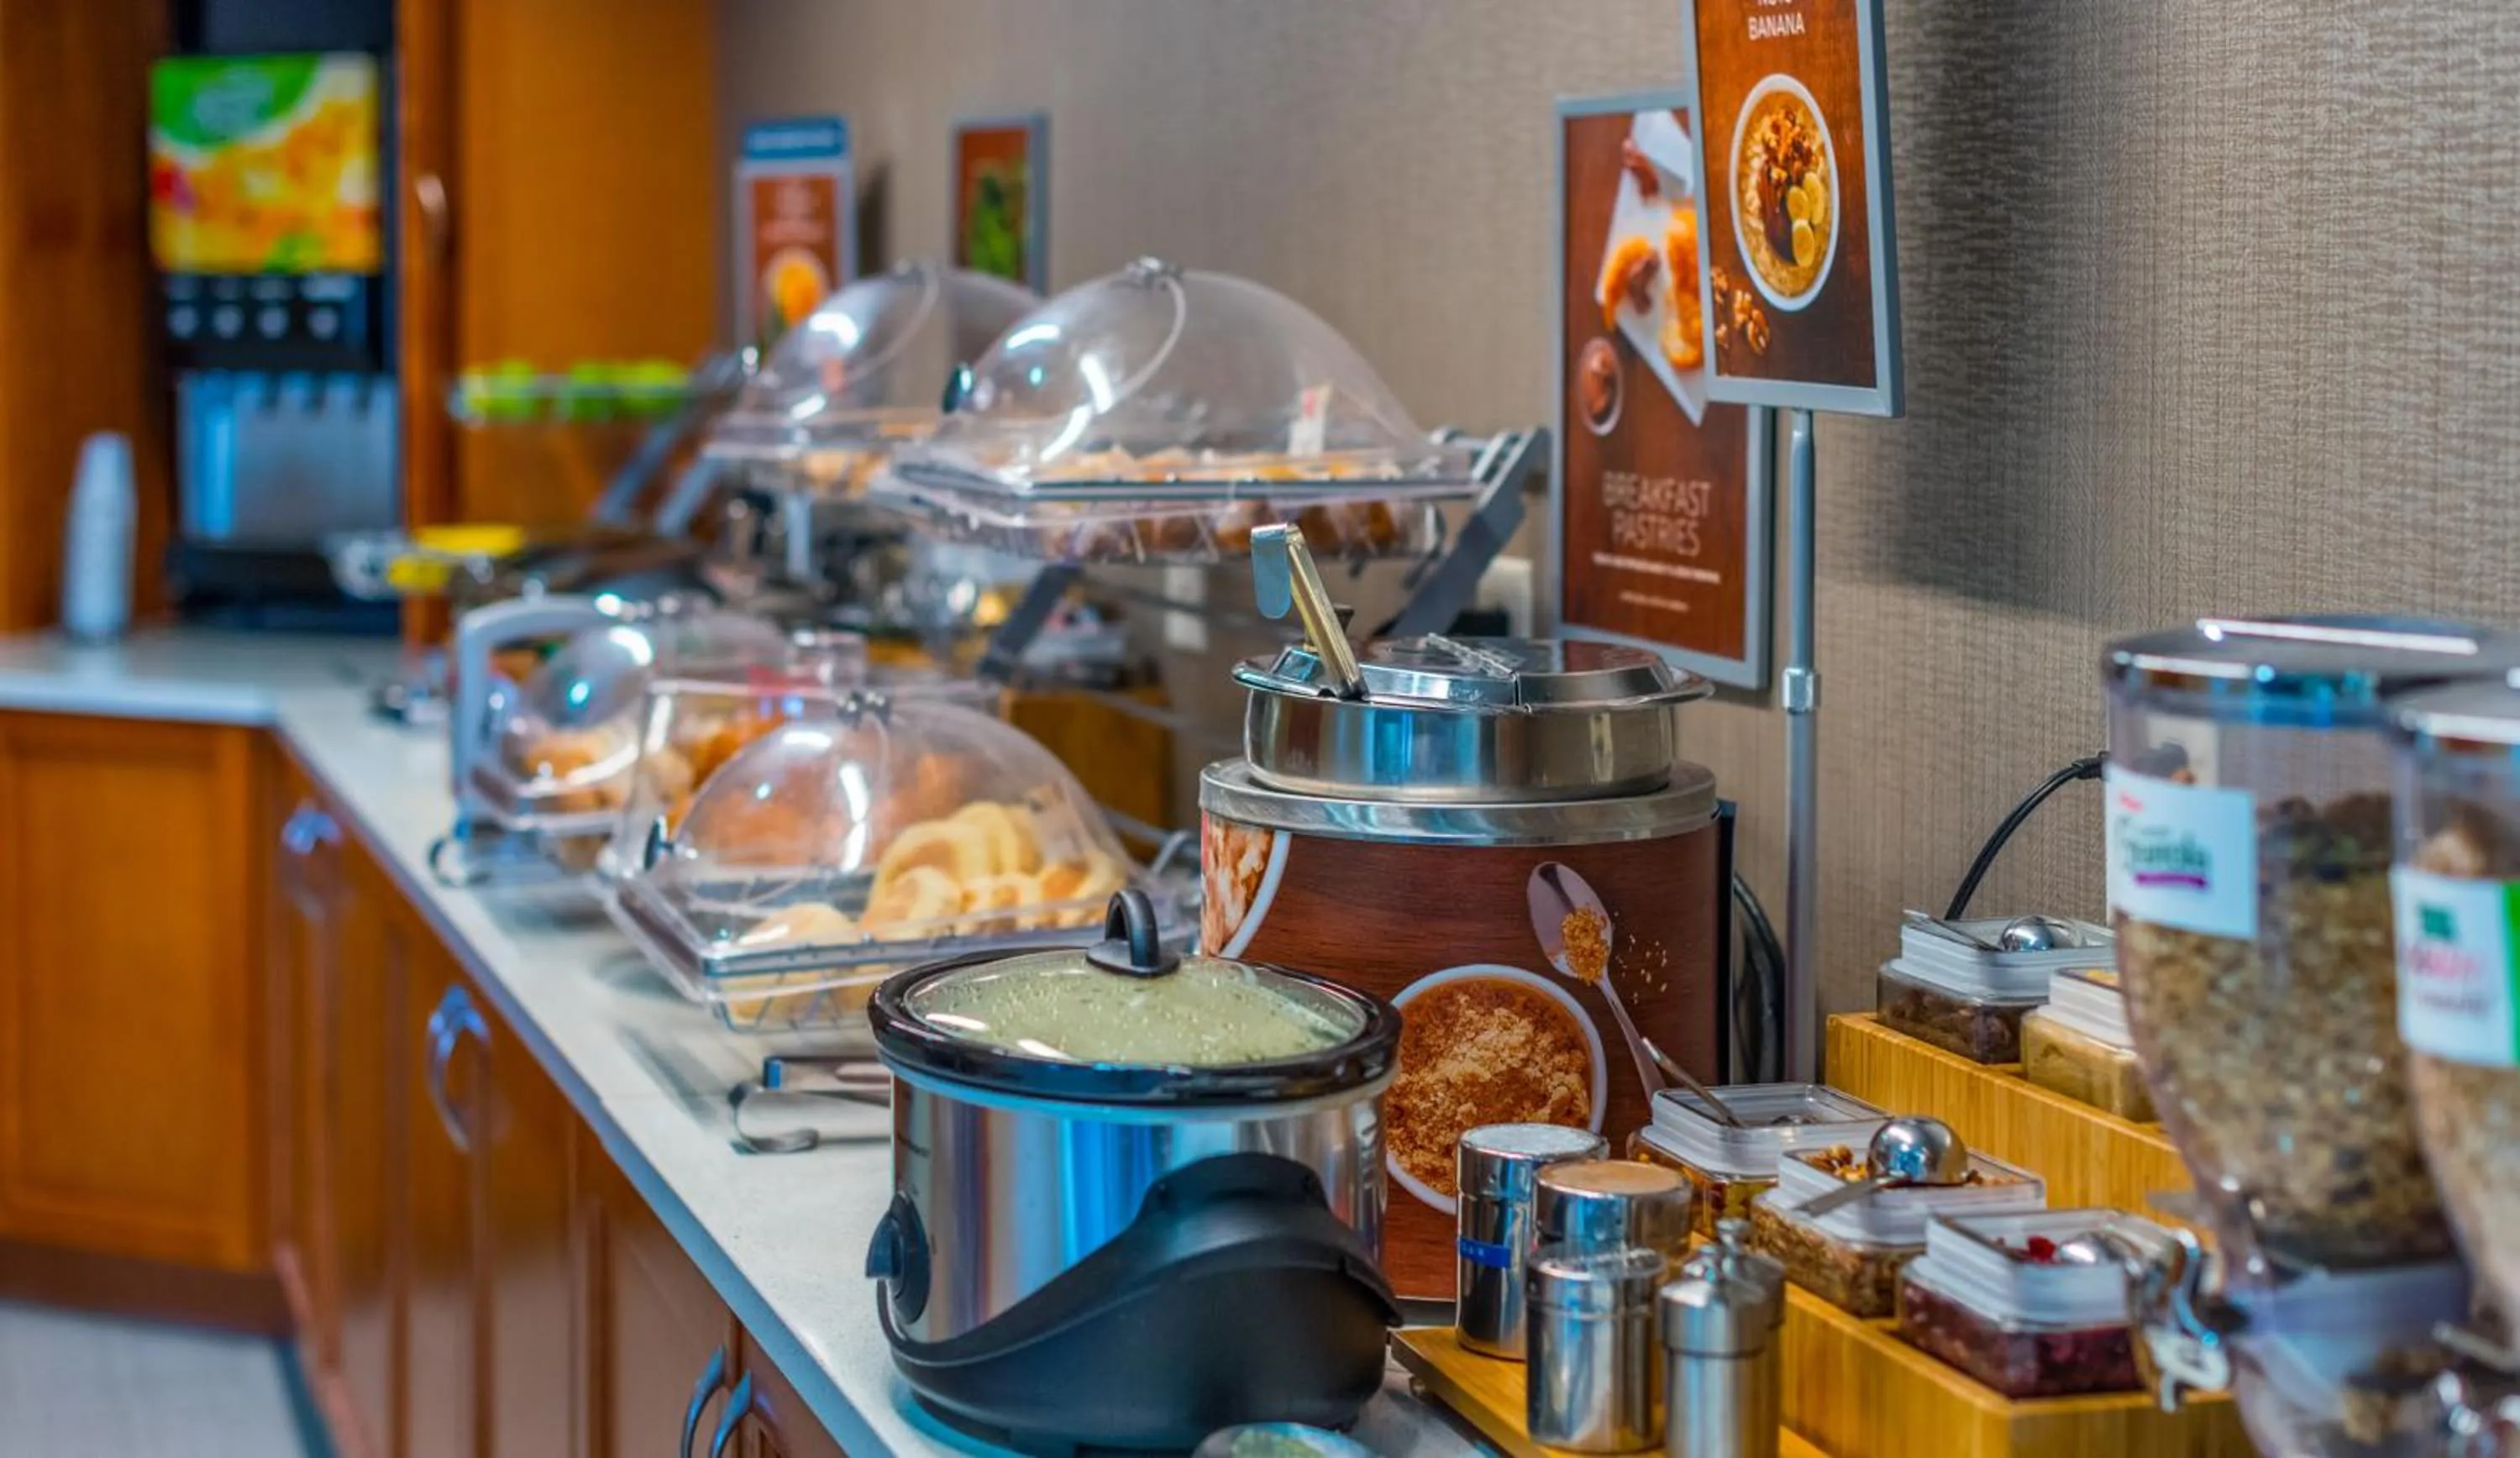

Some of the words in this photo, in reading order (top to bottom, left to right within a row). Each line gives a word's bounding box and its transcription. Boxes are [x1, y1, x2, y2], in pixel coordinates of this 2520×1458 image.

[1748, 12, 1805, 41] BANANA
[1603, 470, 1711, 518] BREAKFAST
[1613, 509, 1701, 557] PASTRIES
